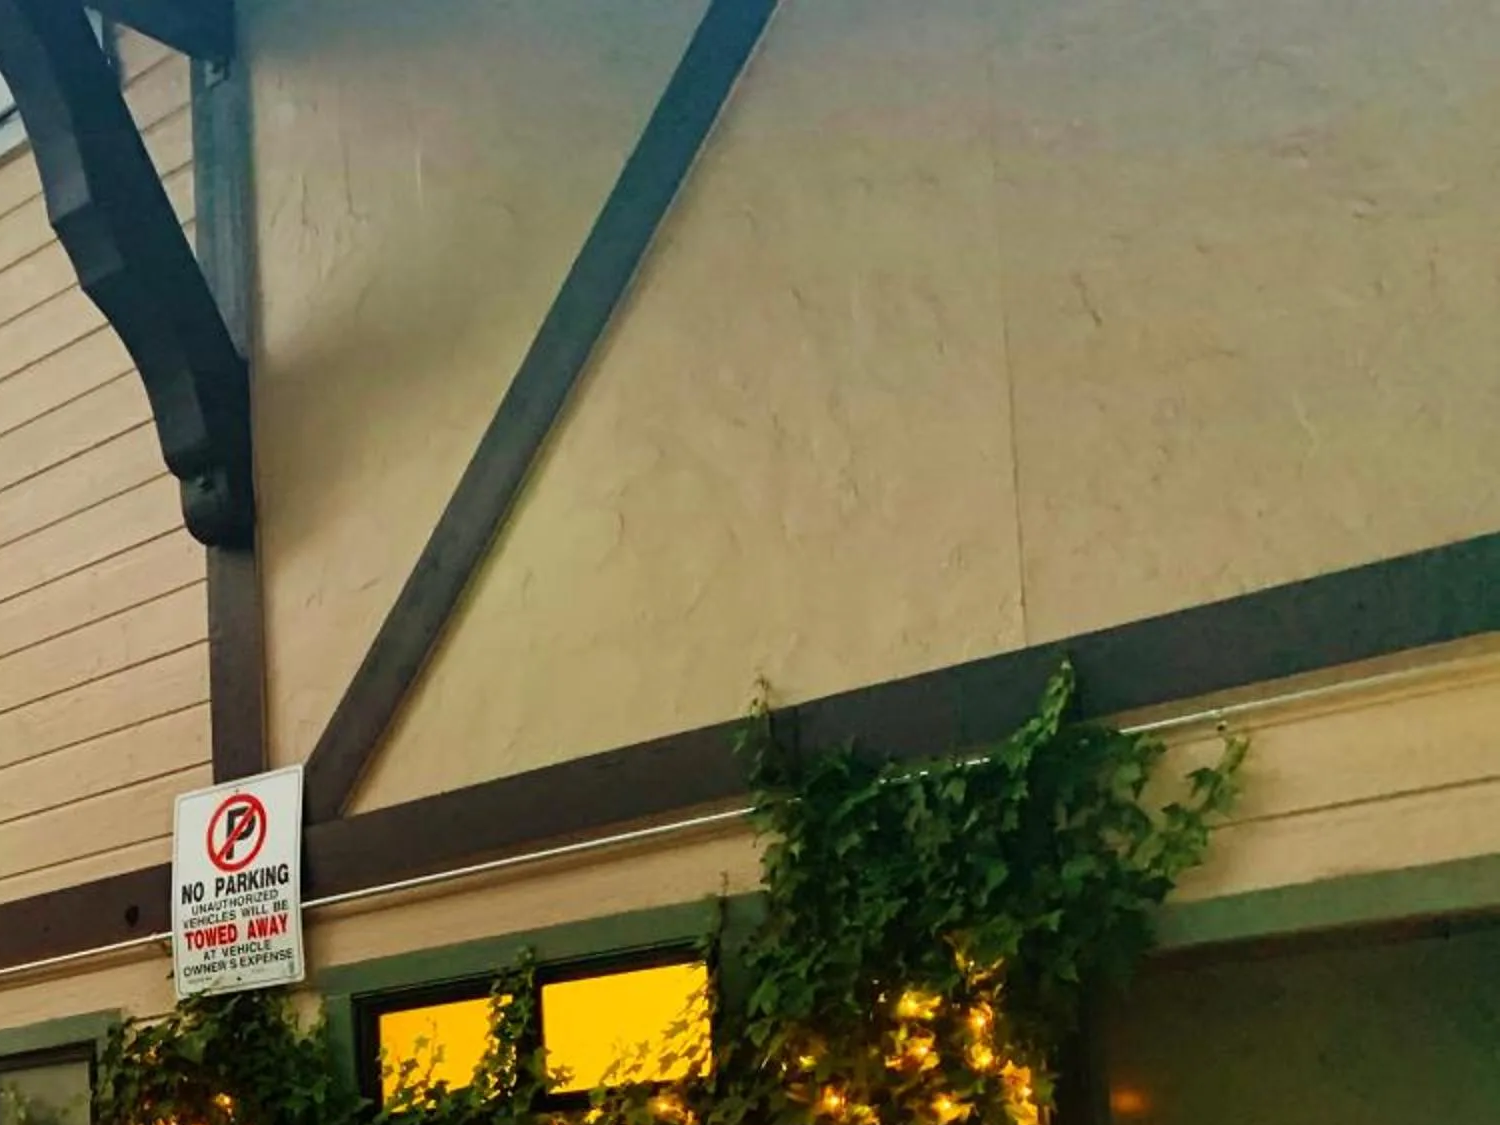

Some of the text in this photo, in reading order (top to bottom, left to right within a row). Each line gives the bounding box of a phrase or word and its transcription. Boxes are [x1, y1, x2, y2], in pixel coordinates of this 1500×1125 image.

[181, 864, 289, 904] NO PARKING
[183, 899, 289, 929] VEHICLES WILL BE
[191, 889, 279, 916] UNAUTHORIZED
[184, 914, 289, 951] TOWED AWAY
[203, 940, 272, 963] AT VEHICLE
[240, 948, 294, 968] EXPENSE
